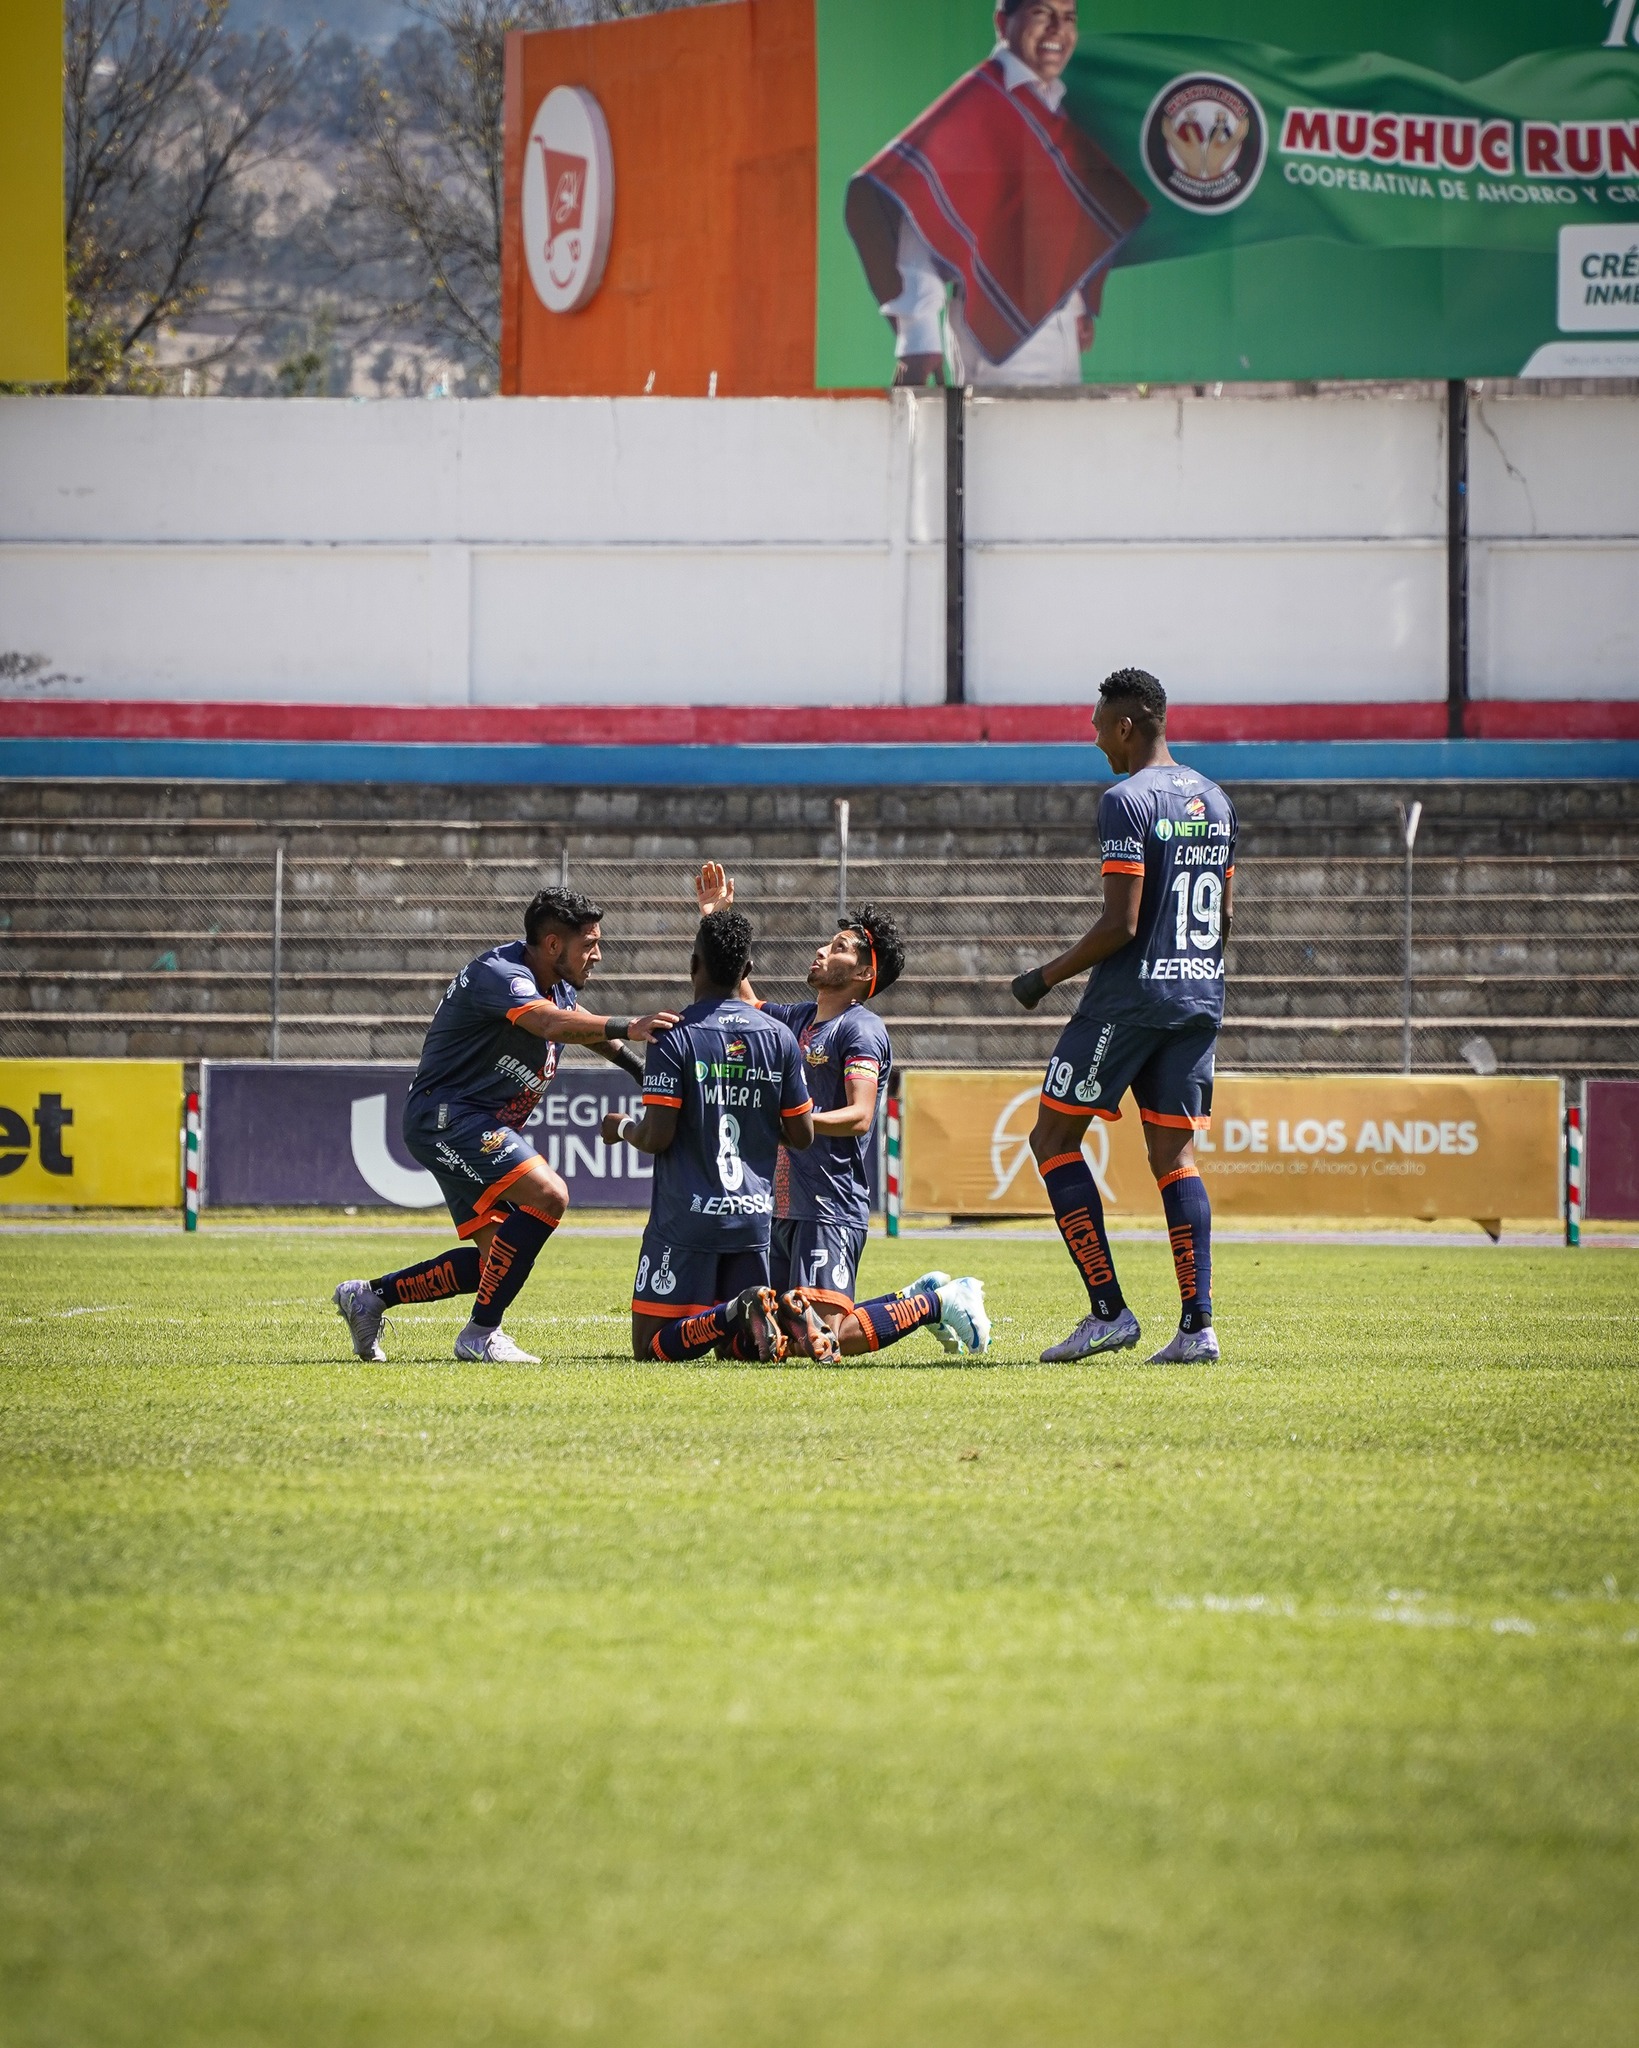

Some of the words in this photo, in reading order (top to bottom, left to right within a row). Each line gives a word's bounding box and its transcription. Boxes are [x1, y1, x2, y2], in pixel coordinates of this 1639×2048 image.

[1282, 109, 1512, 175] MUSHUC
[1284, 161, 1435, 198] COOPERATIVA
[1438, 179, 1469, 200] DE
[1477, 182, 1578, 204] AHORRO
[1581, 186, 1599, 203] Y
[1606, 185, 1639, 203] CR
[1172, 871, 1222, 950] 19
[1150, 958, 1225, 980] EERSSA
[1045, 1056, 1073, 1098] 19
[716, 1113, 744, 1191] 8
[1223, 1119, 1269, 1152] DE
[1278, 1119, 1348, 1154] LOS
[1355, 1120, 1479, 1156] ANDES
[1195, 1158, 1284, 1176] Cooperativa
[1287, 1160, 1308, 1174] de
[1312, 1159, 1357, 1175] Ahorro
[1361, 1164, 1370, 1177] y
[809, 1249, 828, 1286] 7
[1059, 1207, 1113, 1286] CAMERO
[635, 1255, 650, 1292] 8
